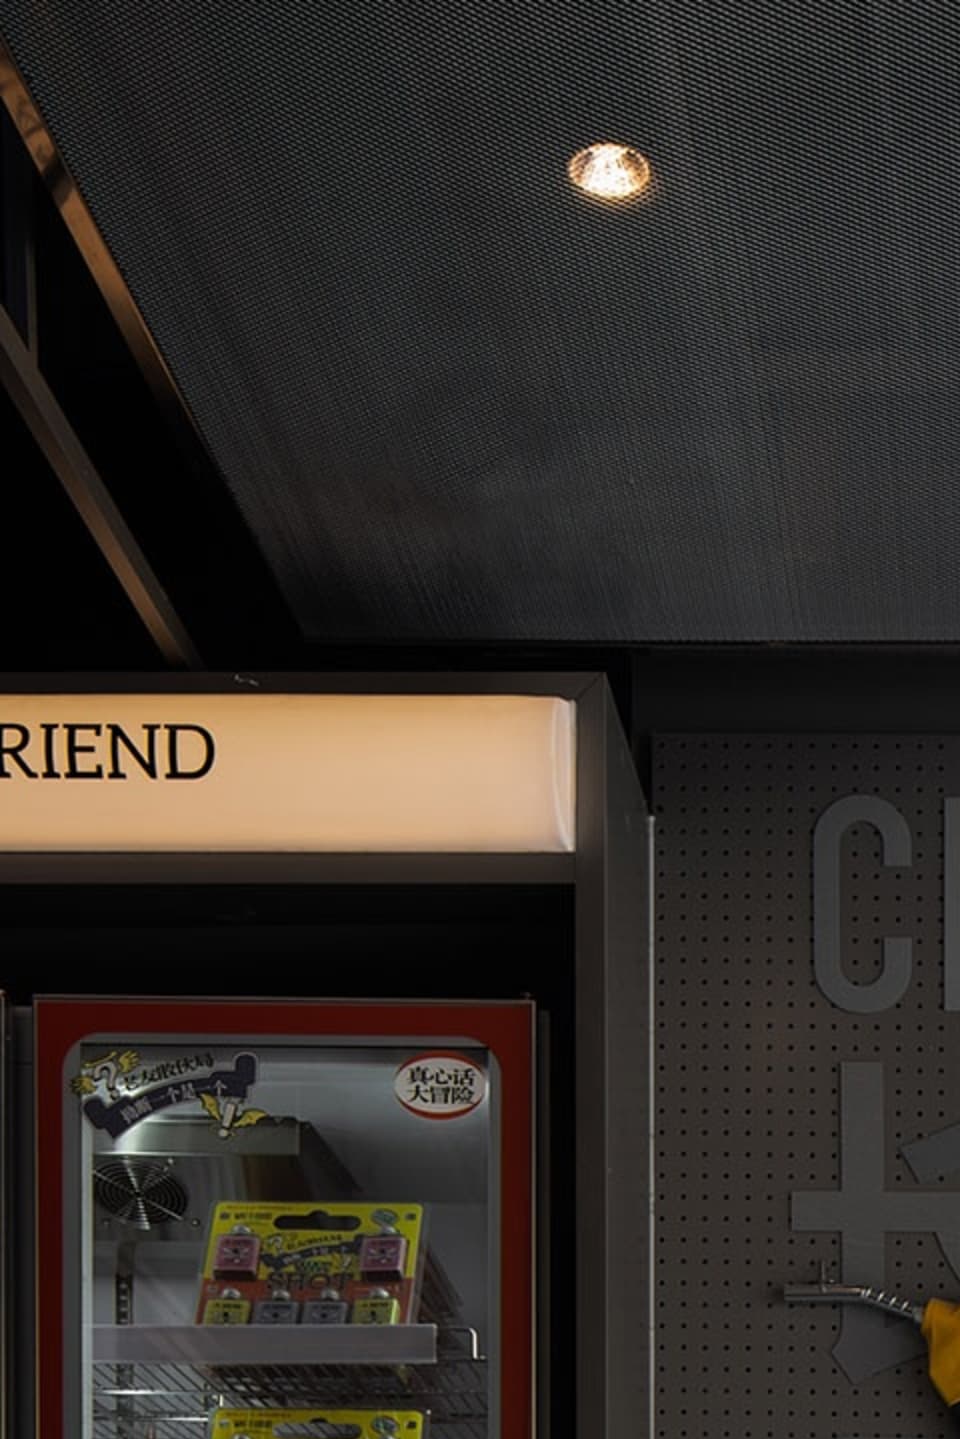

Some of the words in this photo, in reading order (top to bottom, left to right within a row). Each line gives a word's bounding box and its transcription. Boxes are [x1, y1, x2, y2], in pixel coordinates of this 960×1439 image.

[407, 1066, 477, 1087] 真心话
[407, 1085, 477, 1105] 大冒险
